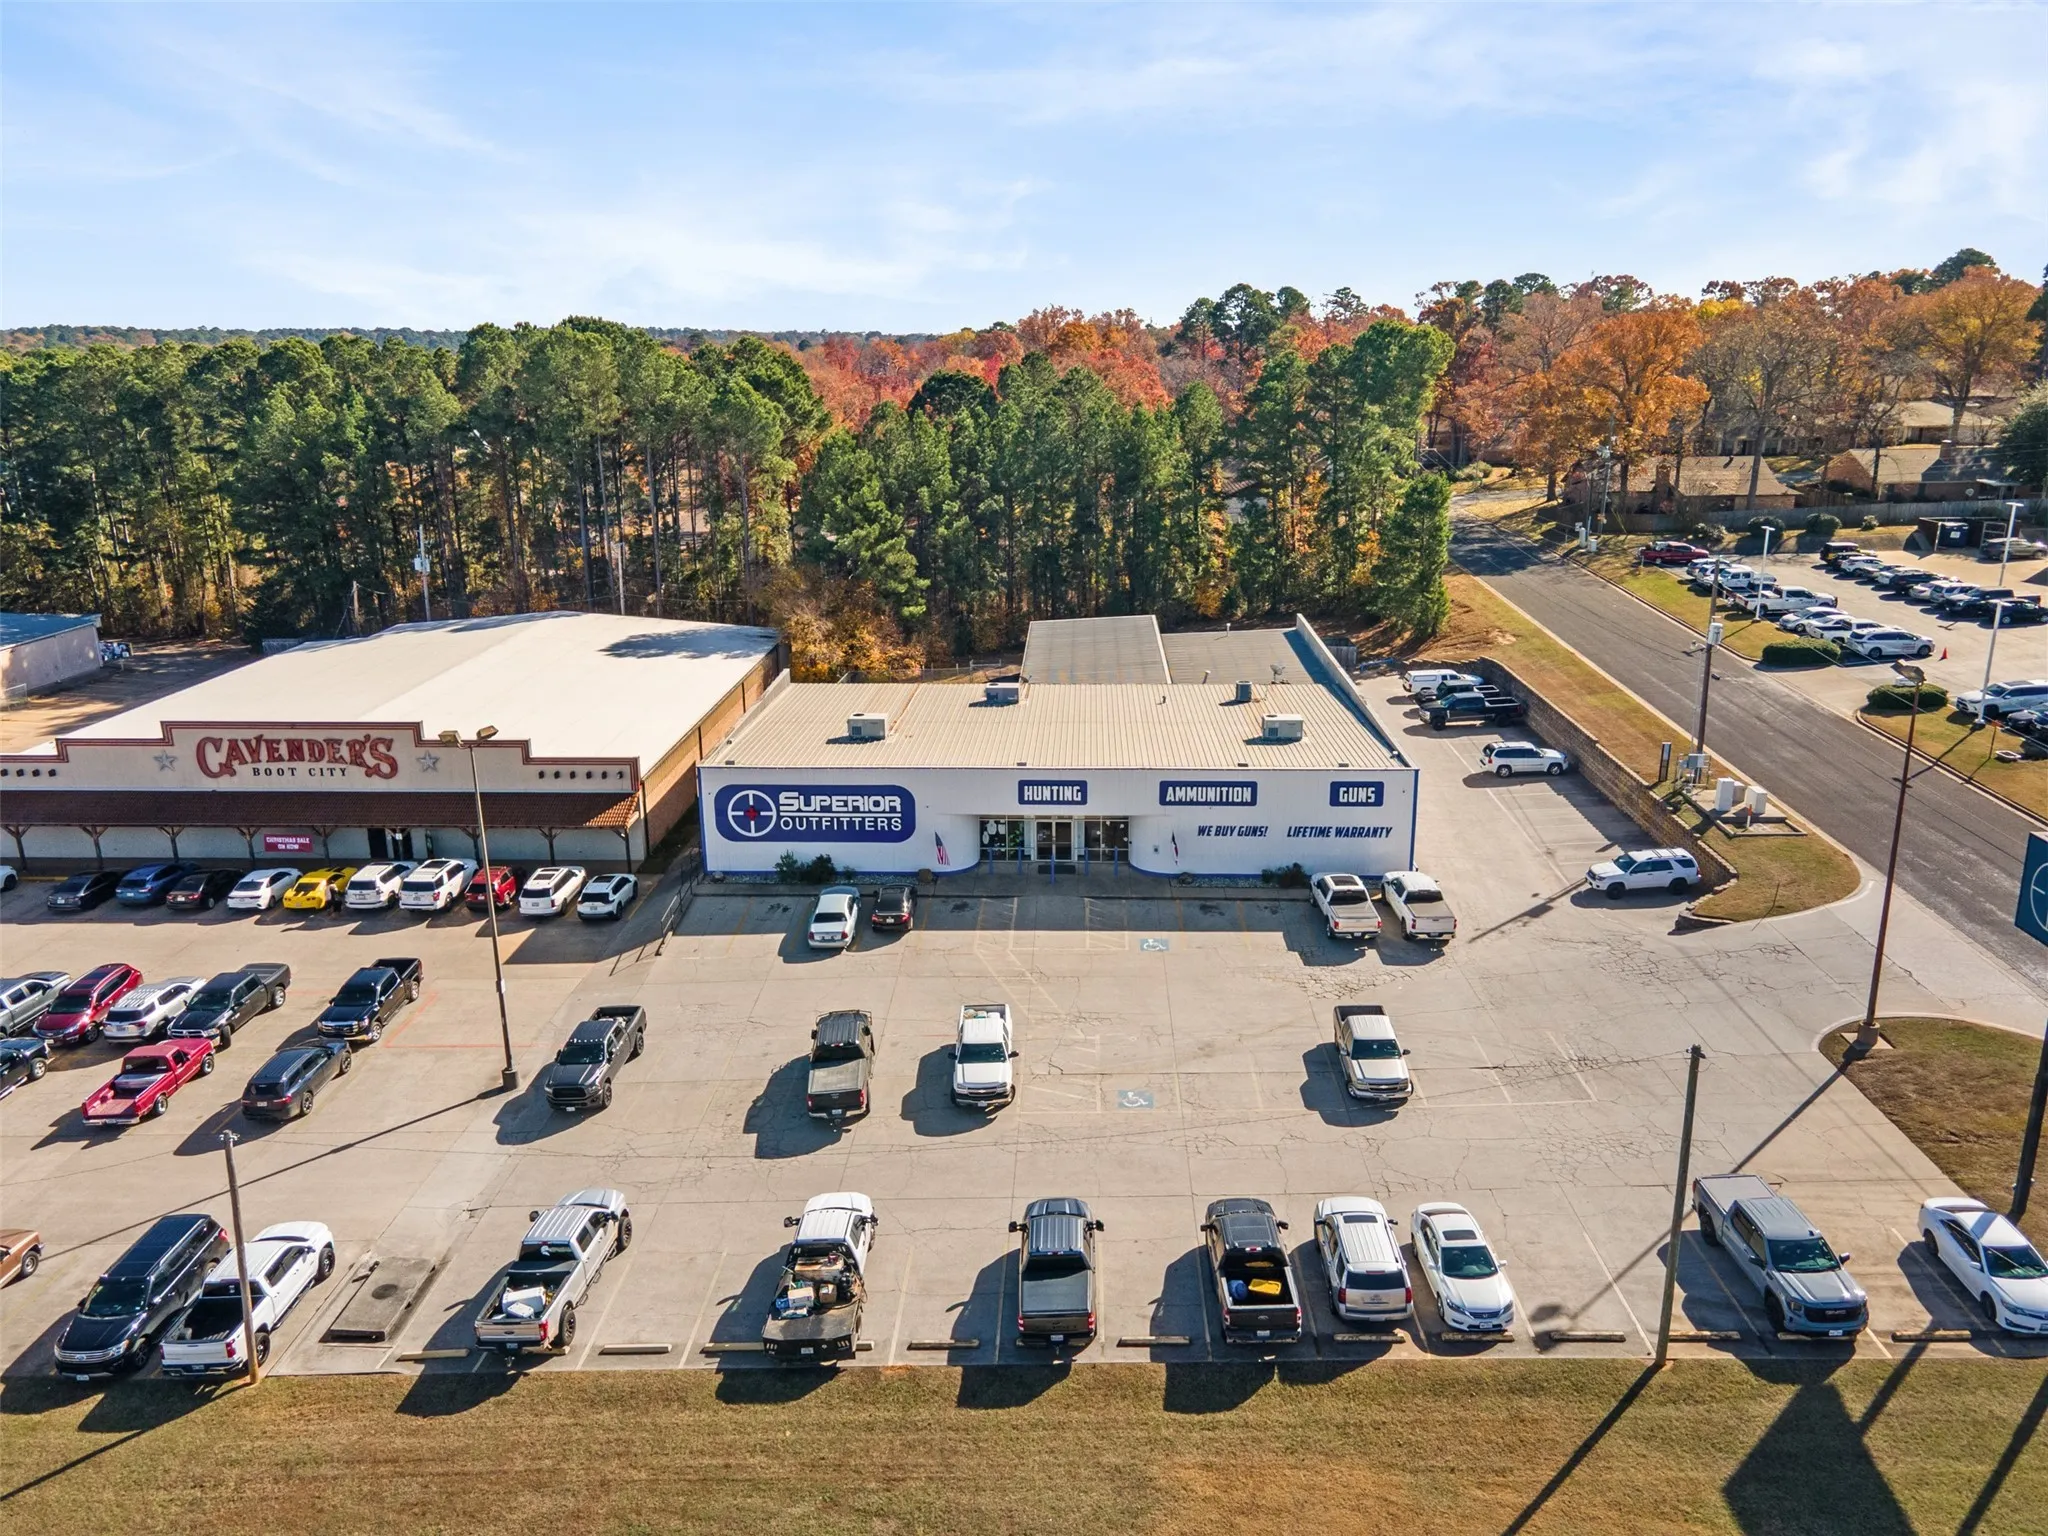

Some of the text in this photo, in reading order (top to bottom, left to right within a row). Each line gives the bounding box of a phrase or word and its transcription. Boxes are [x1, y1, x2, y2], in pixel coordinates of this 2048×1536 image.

[195, 734, 399, 780] CAVENDER'S
[252, 767, 349, 777] BOOT CITY
[1023, 785, 1082, 801] HUNTING
[1165, 786, 1252, 802] AMMUNITION
[1338, 787, 1376, 803] GUNS
[778, 791, 902, 812] SUPERIOR
[779, 817, 902, 831] OUTFITTERS
[1197, 825, 1269, 838] WE BUY GUNS!
[1286, 826, 1393, 839] LIFETIME WARRANTY
